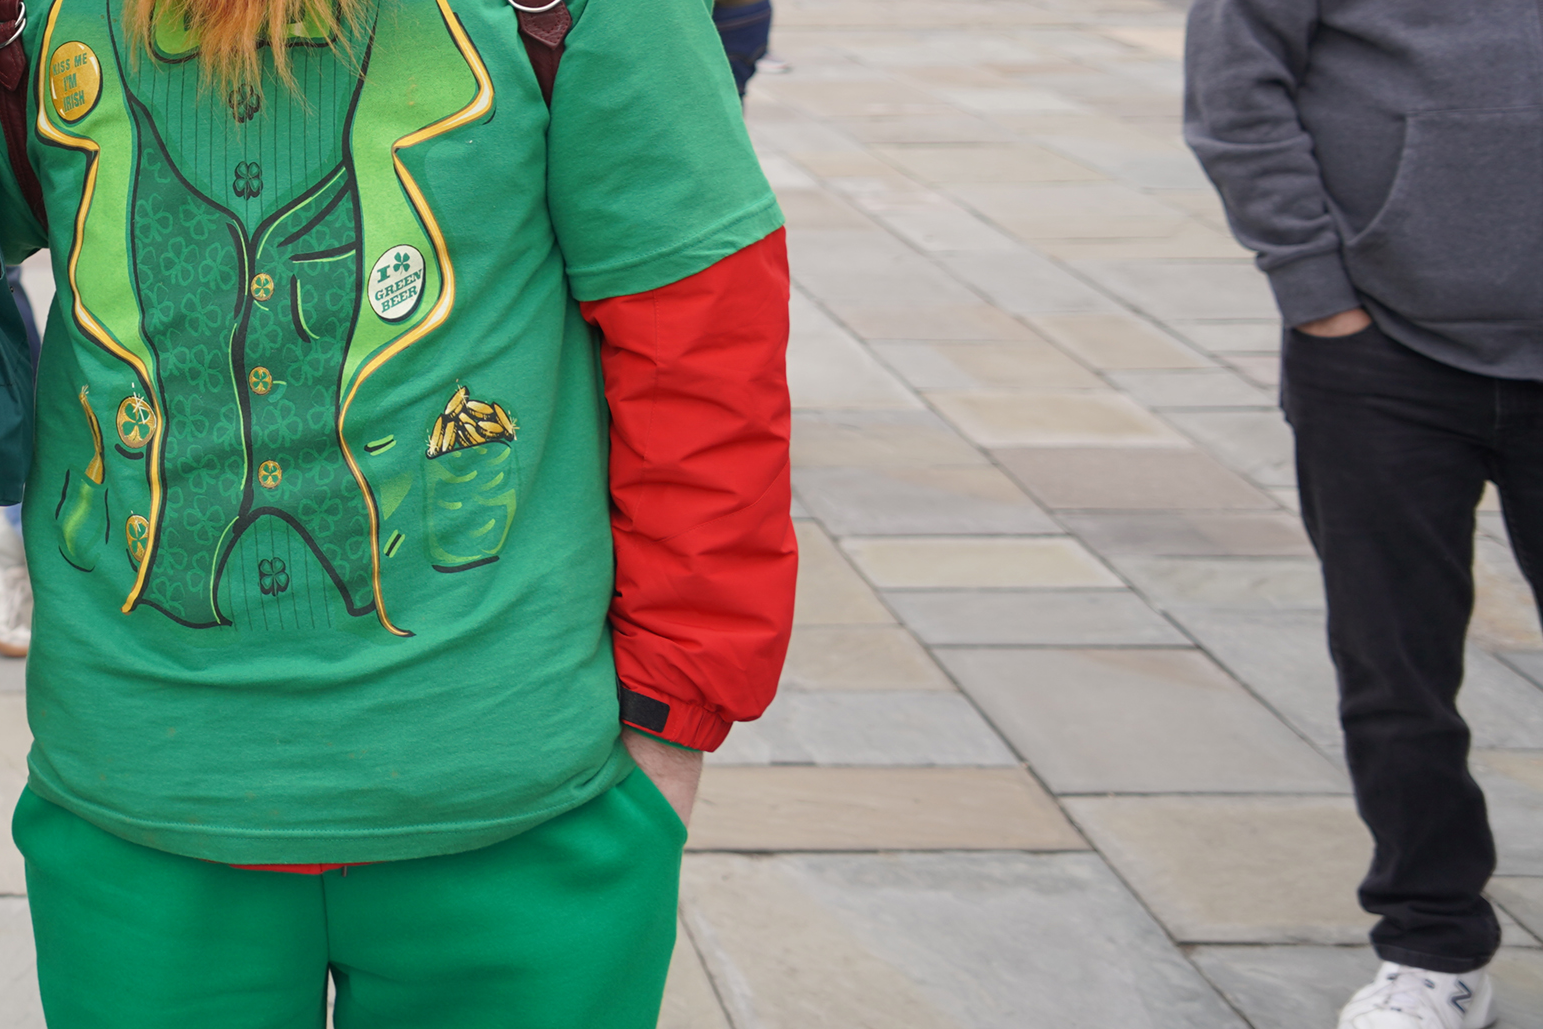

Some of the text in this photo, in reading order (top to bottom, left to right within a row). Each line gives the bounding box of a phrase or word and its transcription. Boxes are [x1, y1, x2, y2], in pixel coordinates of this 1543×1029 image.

[53, 53, 88, 76] KISS ME
[63, 73, 77, 91] I'M
[64, 90, 85, 112] IRISH
[374, 269, 422, 302] GREEN
[377, 265, 390, 284] I
[381, 285, 418, 313] BEER
